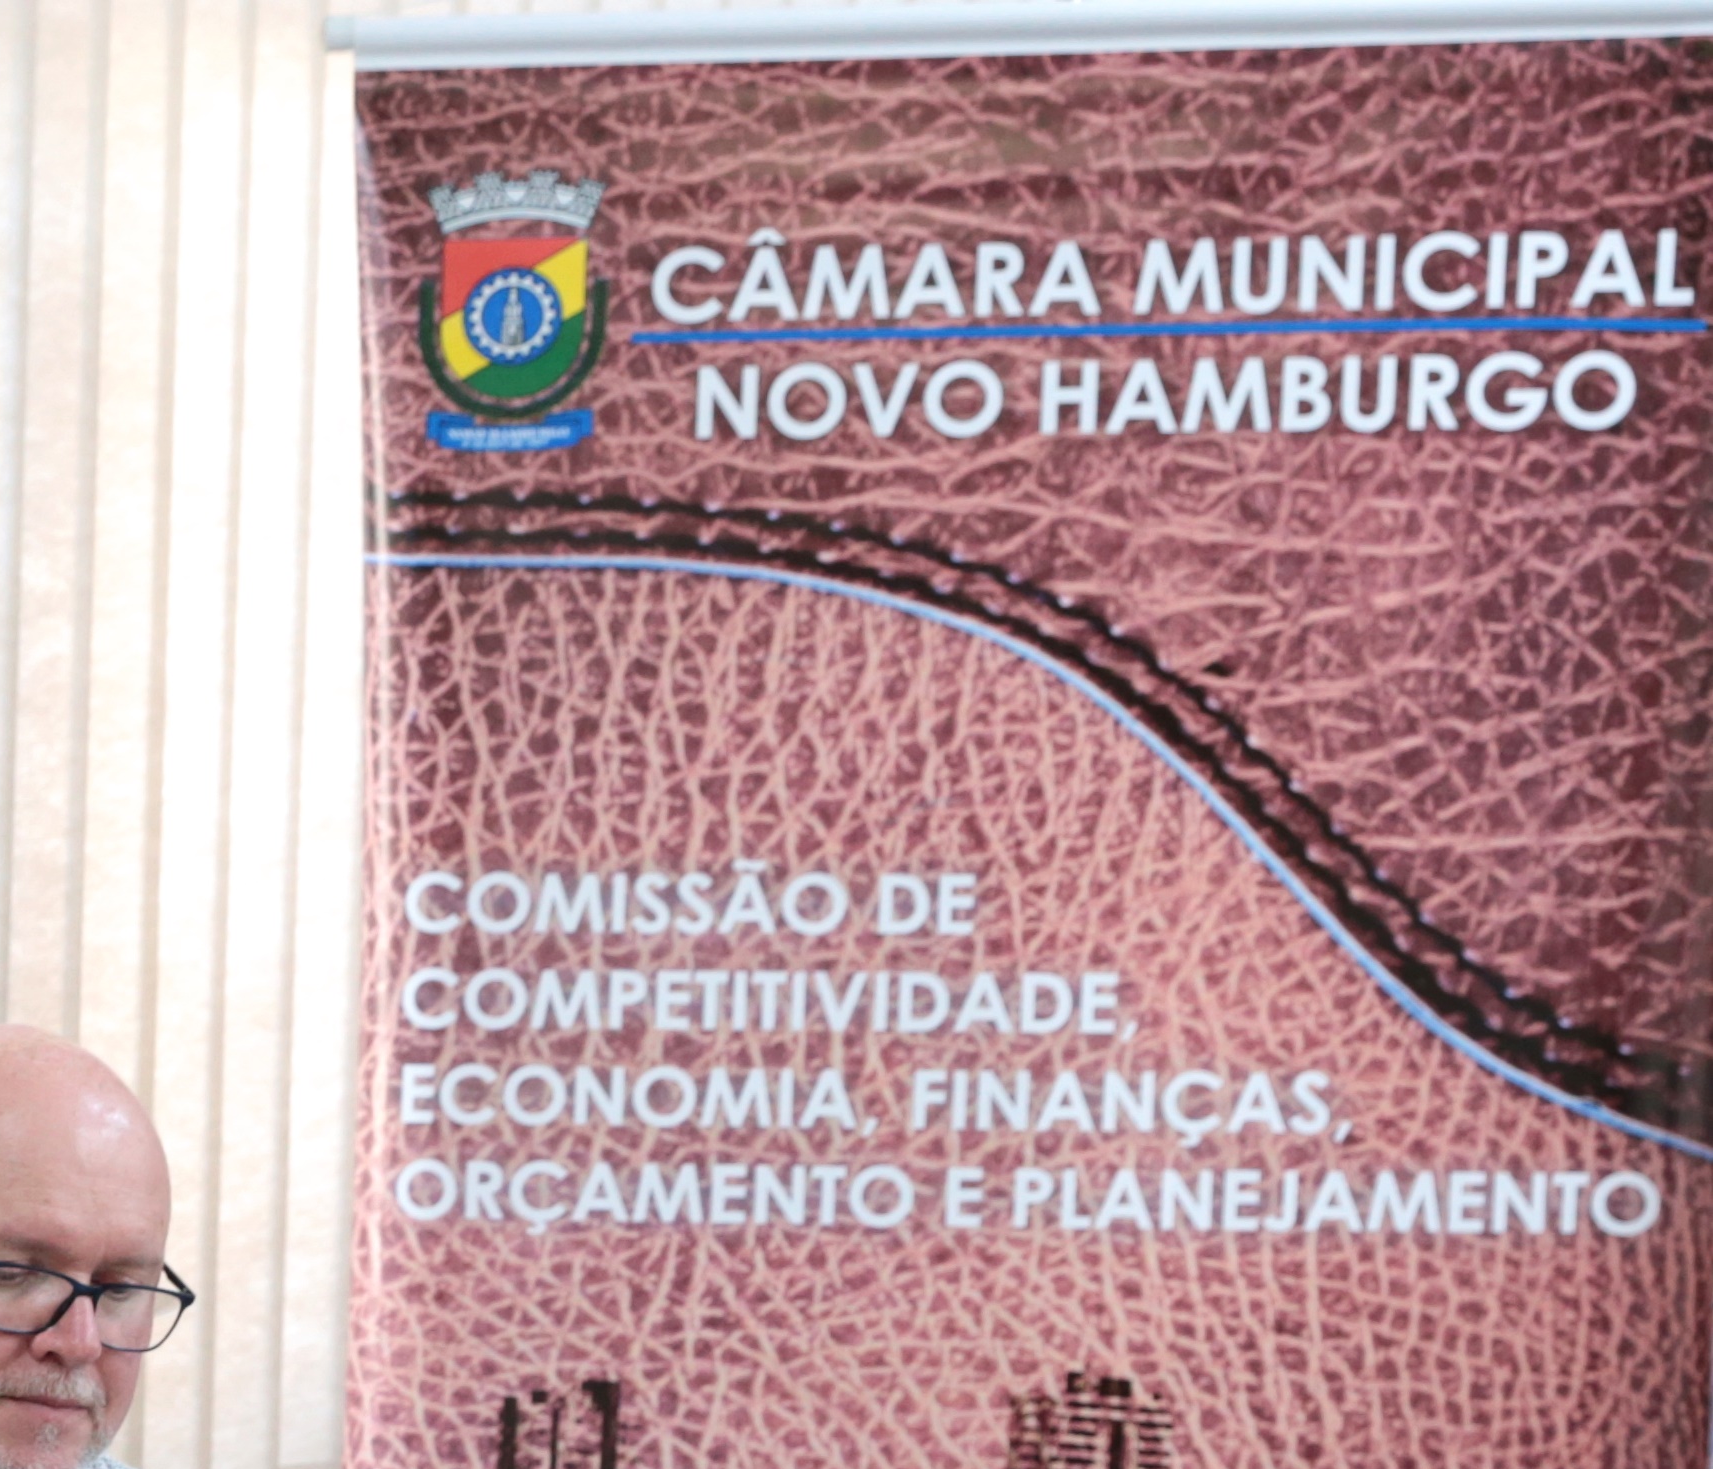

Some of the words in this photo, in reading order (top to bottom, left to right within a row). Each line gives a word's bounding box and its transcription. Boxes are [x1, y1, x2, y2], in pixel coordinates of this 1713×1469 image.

[650, 227, 1101, 323] CÂMARA
[1135, 227, 1695, 315] MUNICIPAL
[693, 361, 1003, 441] NOVO
[1038, 351, 1637, 436] HAMBURGO
[402, 857, 849, 937] COMISSÃO
[876, 870, 977, 936] DE
[400, 966, 1139, 1042] COMPETITIVIDADE,
[398, 1062, 881, 1140] ECONOMIA,
[911, 1066, 1355, 1150] FINANÇAS,
[395, 1158, 916, 1238] ORÇAMENTO
[944, 1166, 983, 1229] E
[1012, 1168, 1661, 1239] PLANEJAMENTO
